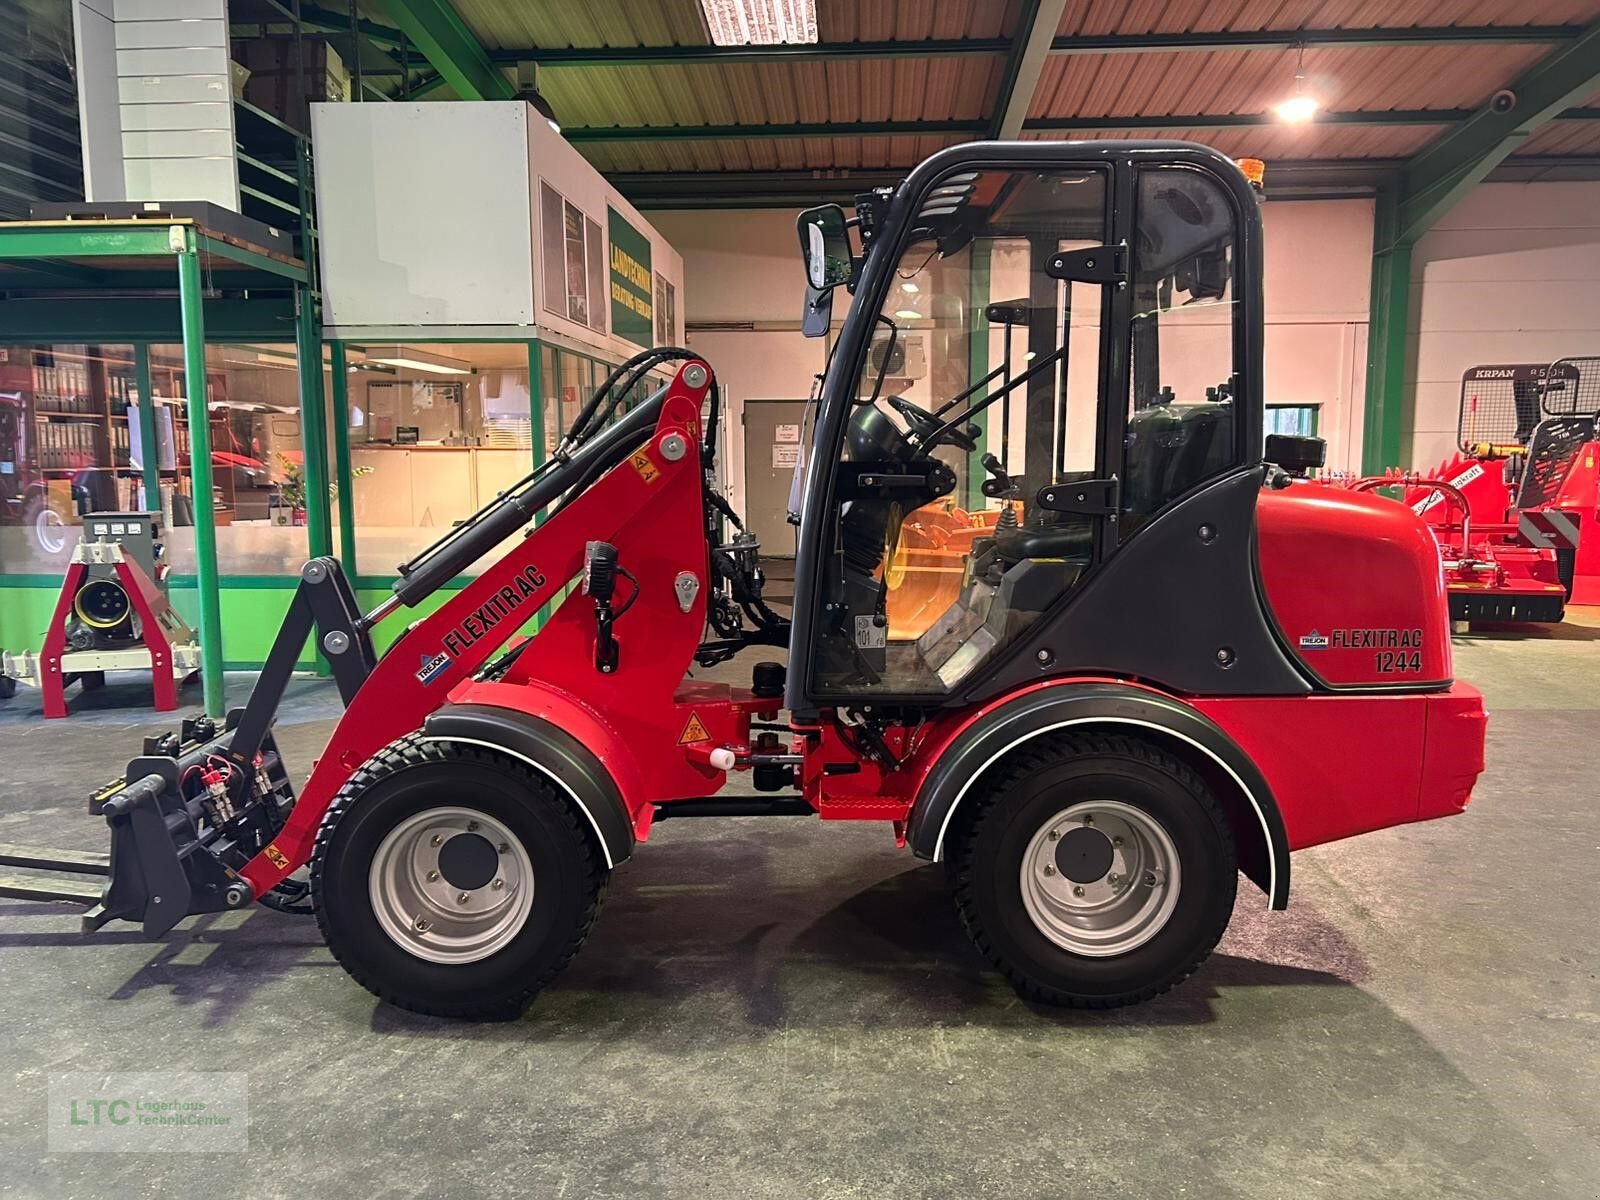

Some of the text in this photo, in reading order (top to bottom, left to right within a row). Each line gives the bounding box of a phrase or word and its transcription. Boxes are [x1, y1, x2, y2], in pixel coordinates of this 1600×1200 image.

[1475, 369, 1515, 378] KRPAN
[418, 565, 546, 679] TREJON FLEXITRAC
[1332, 629, 1422, 648] FLEXITRAC
[1375, 651, 1422, 673] 1244
